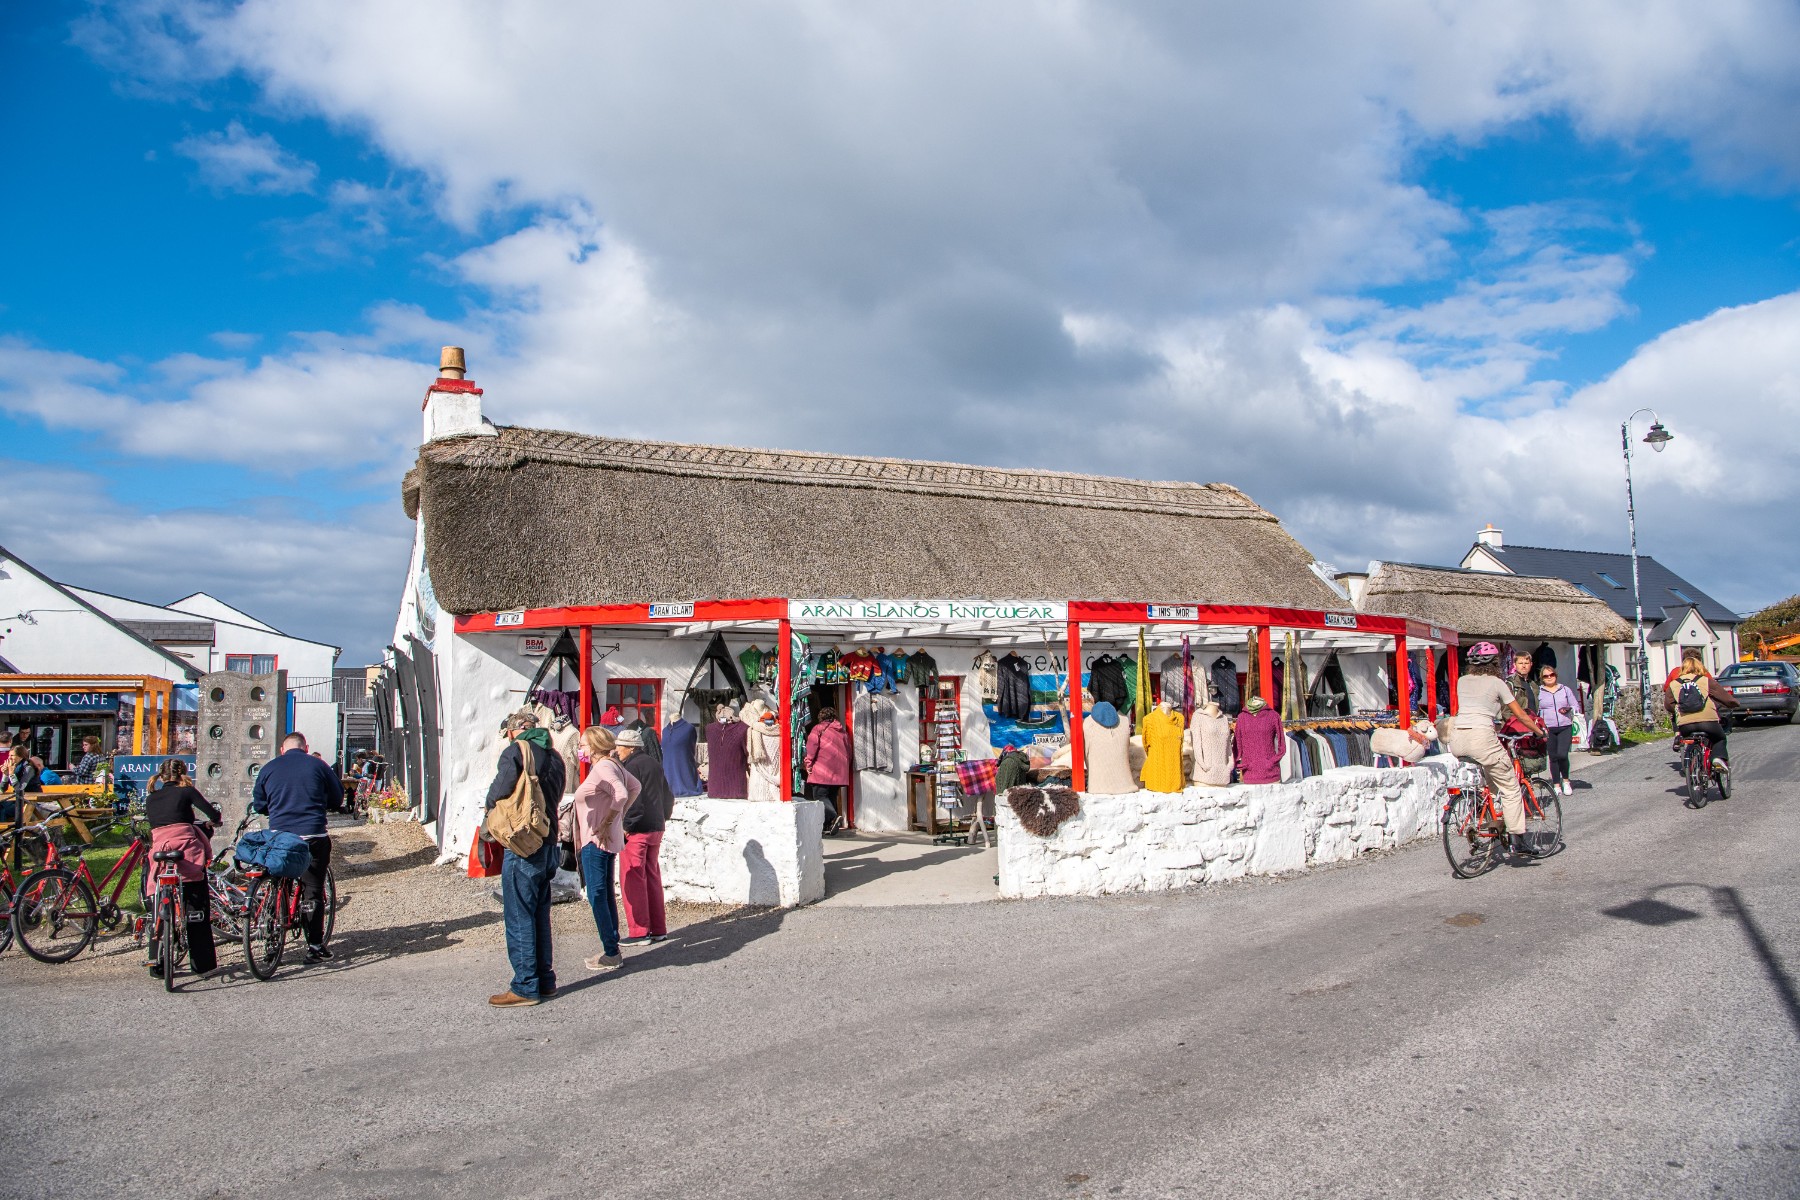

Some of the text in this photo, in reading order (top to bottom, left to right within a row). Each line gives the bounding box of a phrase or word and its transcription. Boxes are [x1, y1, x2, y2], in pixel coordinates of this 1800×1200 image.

[654, 605, 693, 616] ARAN ISLAND
[801, 602, 1055, 619] ARAN ISLANDS KNITWEAR
[1158, 607, 1190, 618] INIS MOR
[68, 693, 108, 706] CAFE
[119, 763, 152, 773] ARAN
